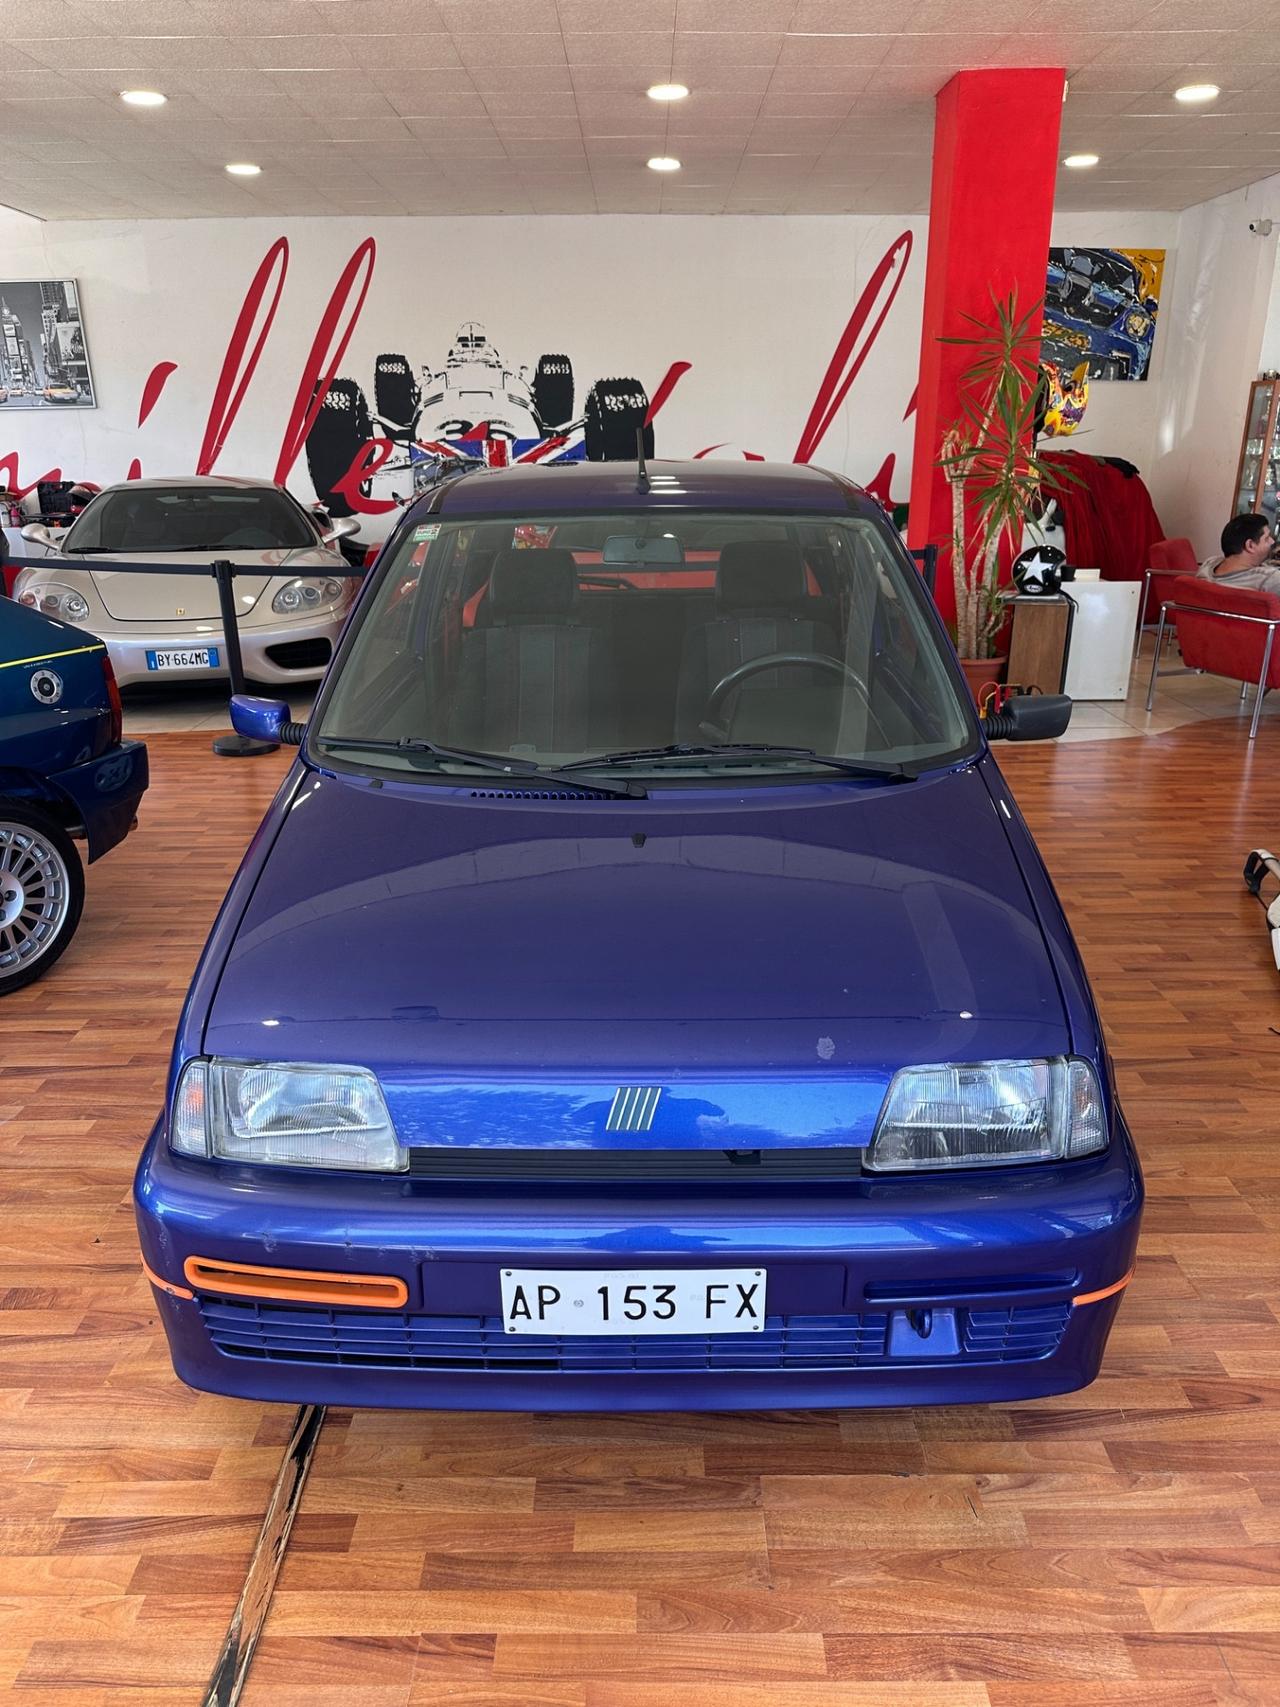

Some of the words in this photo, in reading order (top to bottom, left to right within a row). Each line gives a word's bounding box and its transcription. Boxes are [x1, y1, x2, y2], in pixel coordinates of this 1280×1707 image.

[509, 1285, 561, 1320] AP
[597, 1284, 677, 1321] 153
[705, 1283, 759, 1319] FX
